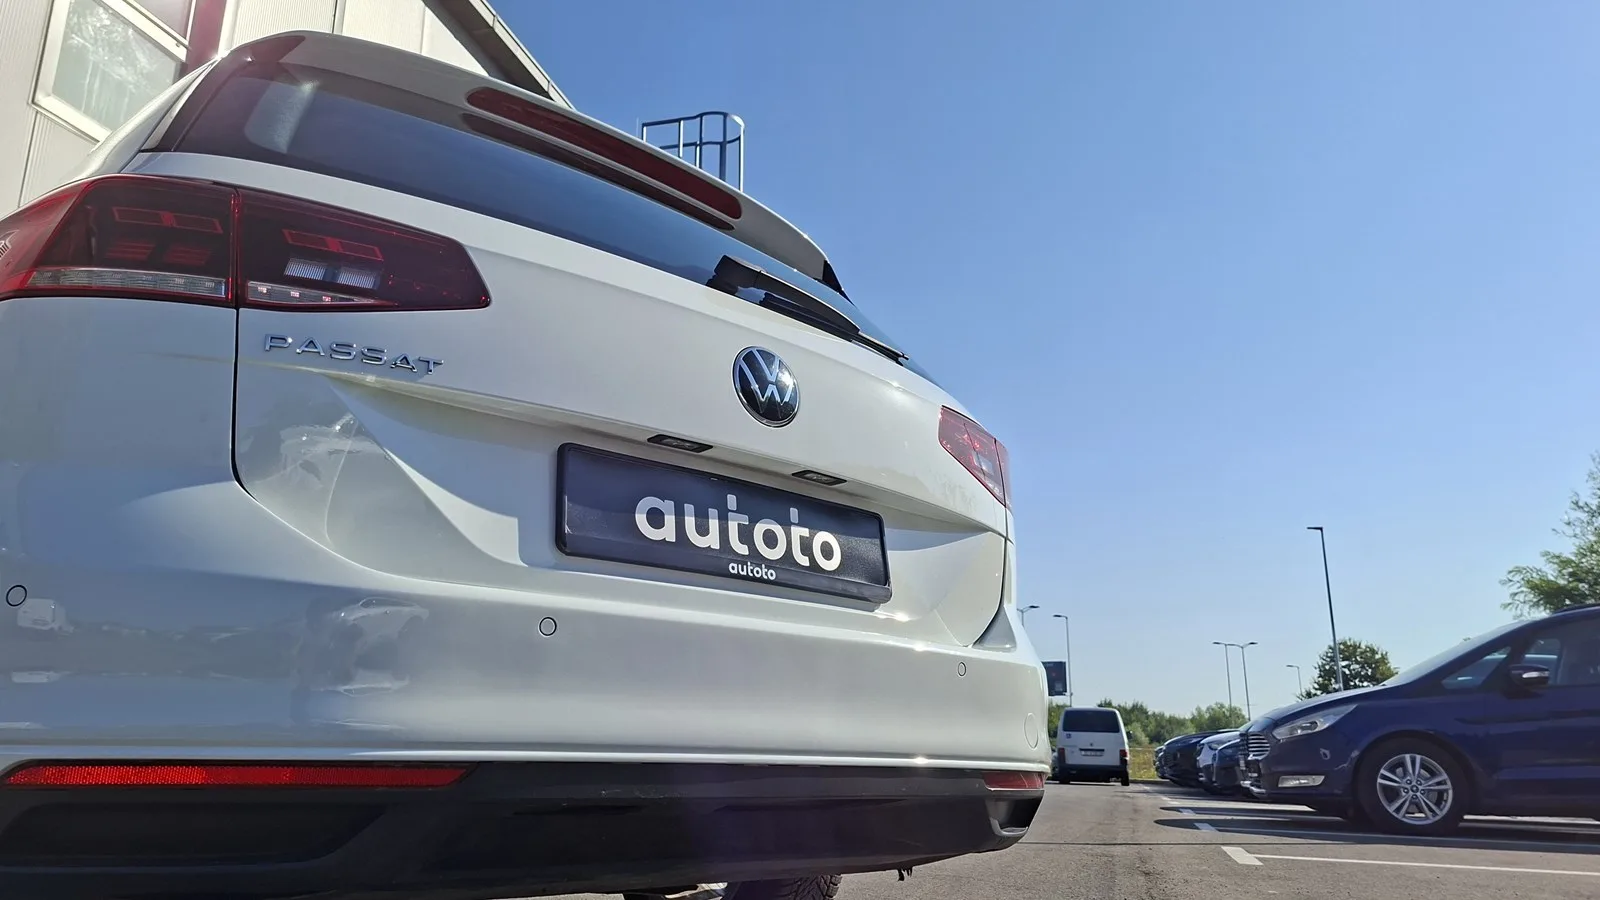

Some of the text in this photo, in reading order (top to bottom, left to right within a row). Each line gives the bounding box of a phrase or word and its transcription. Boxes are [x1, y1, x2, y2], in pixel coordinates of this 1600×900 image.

[264, 333, 444, 375] PASSAT
[634, 494, 842, 572] autoto
[728, 561, 777, 581] autoto
